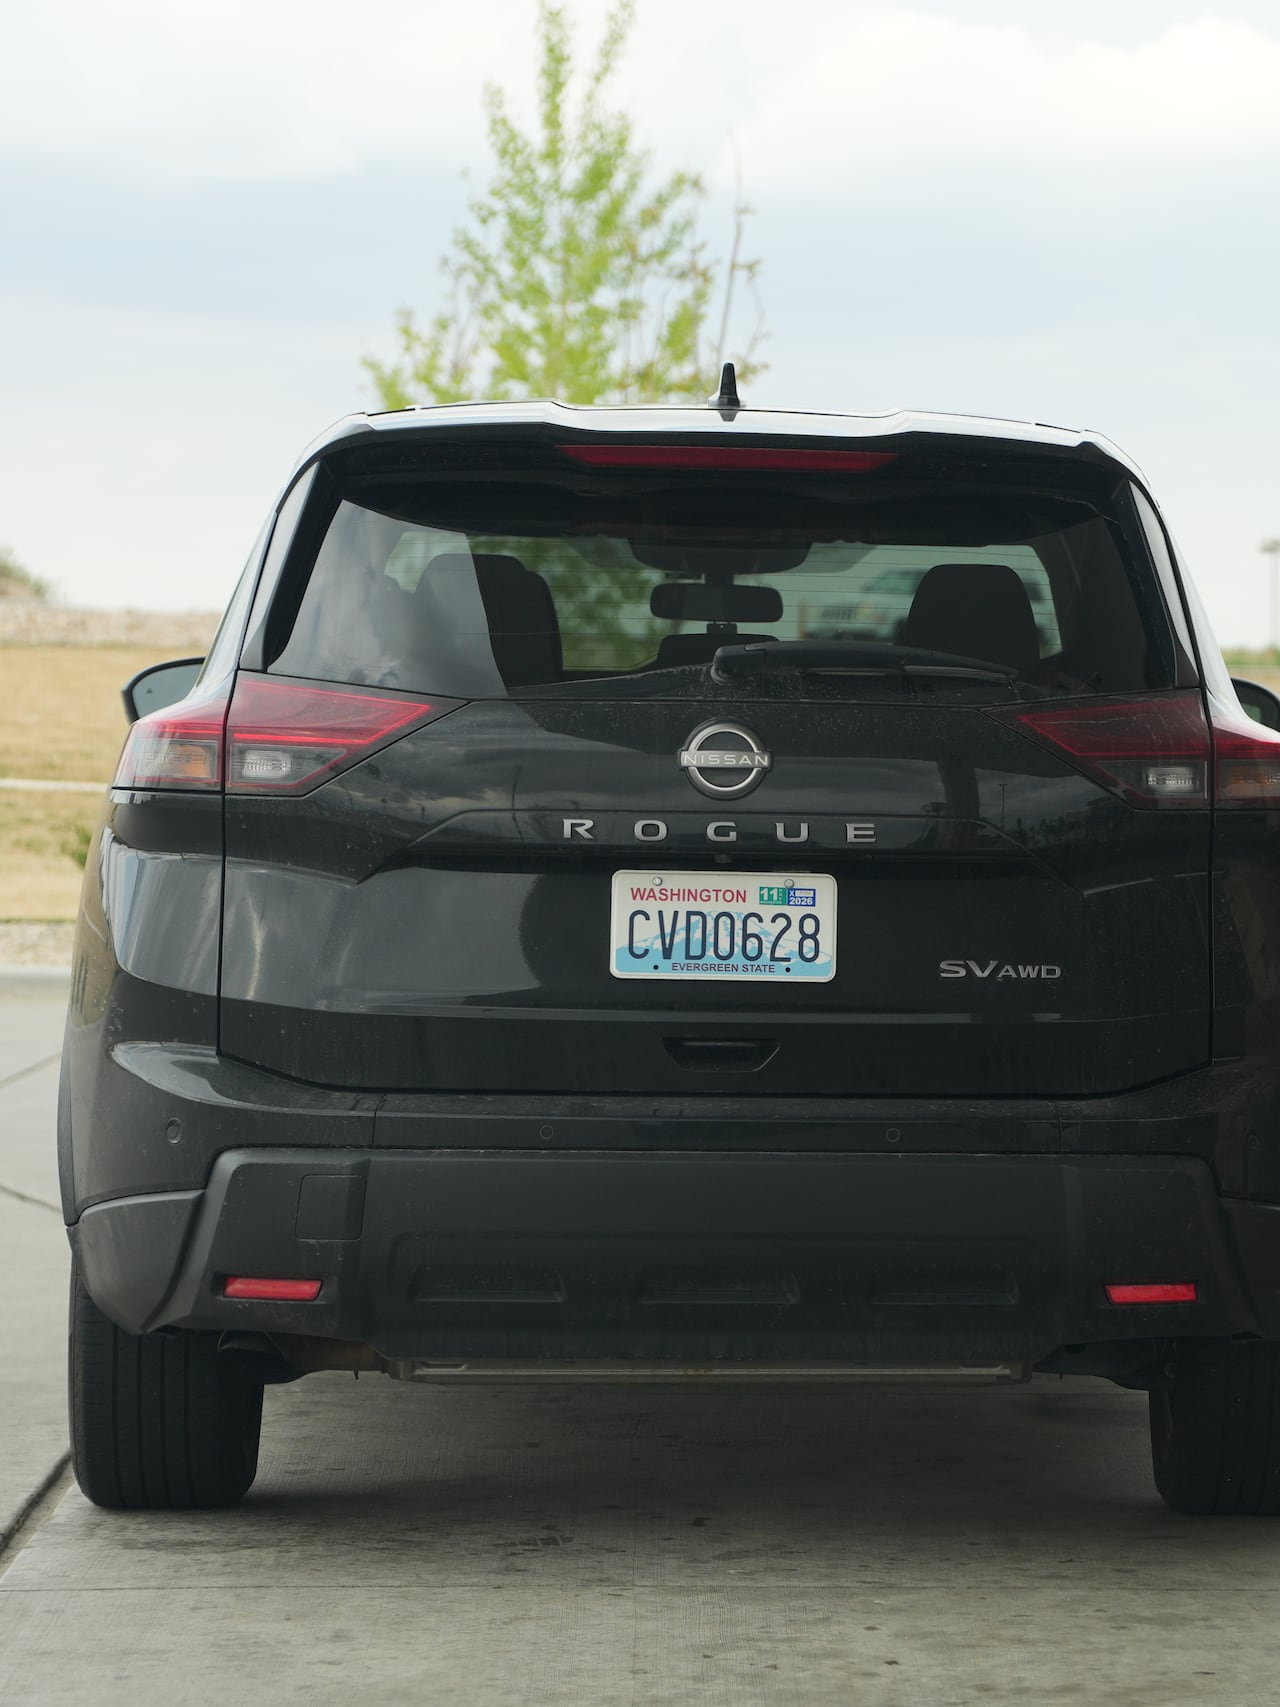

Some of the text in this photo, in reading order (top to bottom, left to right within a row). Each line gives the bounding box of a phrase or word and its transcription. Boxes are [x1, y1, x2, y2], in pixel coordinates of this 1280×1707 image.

[684, 754, 768, 766] NISSAN
[562, 818, 876, 842] ROGUE
[631, 888, 746, 903] WASHINGTON
[760, 888, 778, 900] 11
[628, 909, 820, 963] CVD0628
[672, 963, 775, 973] EVERGREEN STATE
